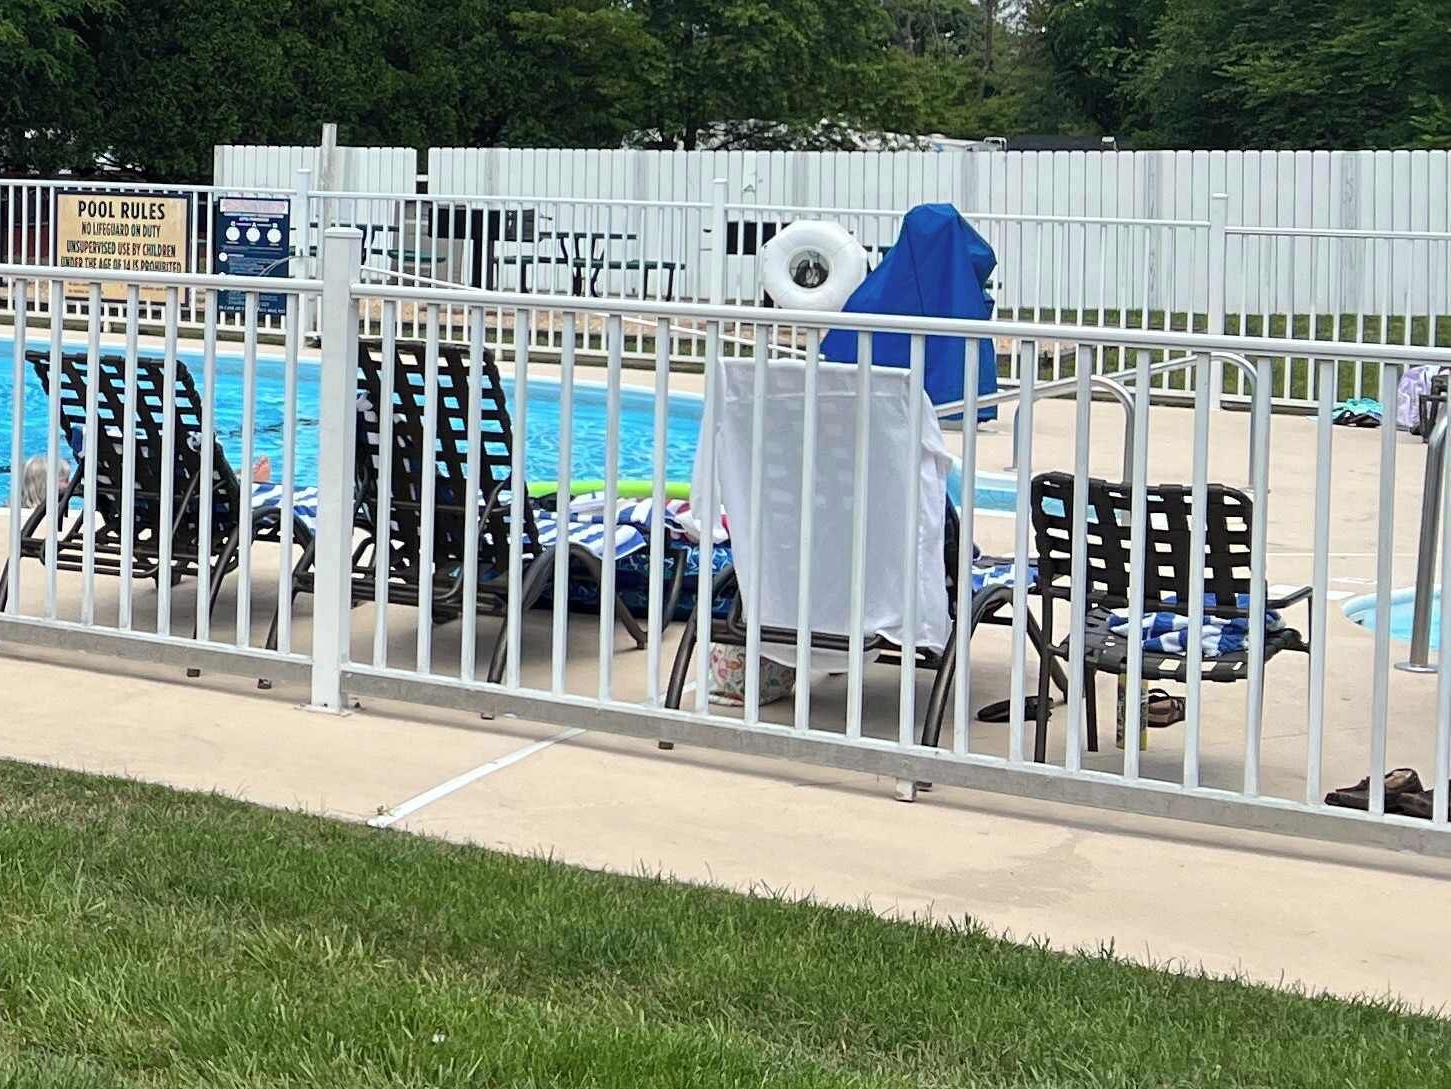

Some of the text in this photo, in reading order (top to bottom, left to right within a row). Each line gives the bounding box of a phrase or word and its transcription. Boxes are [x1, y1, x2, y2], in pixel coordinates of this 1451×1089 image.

[77, 200, 165, 220] POOL RULES
[81, 222, 161, 238] NO LIFEGUARD ON DUTY
[66, 240, 176, 257] UNSUPERVISED USE BY CHILDREN
[60, 256, 83, 268] UNDER
[85, 257, 97, 269] THE
[98, 258, 112, 270] AGE
[113, 258, 122, 270] OF
[132, 259, 139, 271] IS
[140, 260, 182, 273] PROHIBITED
